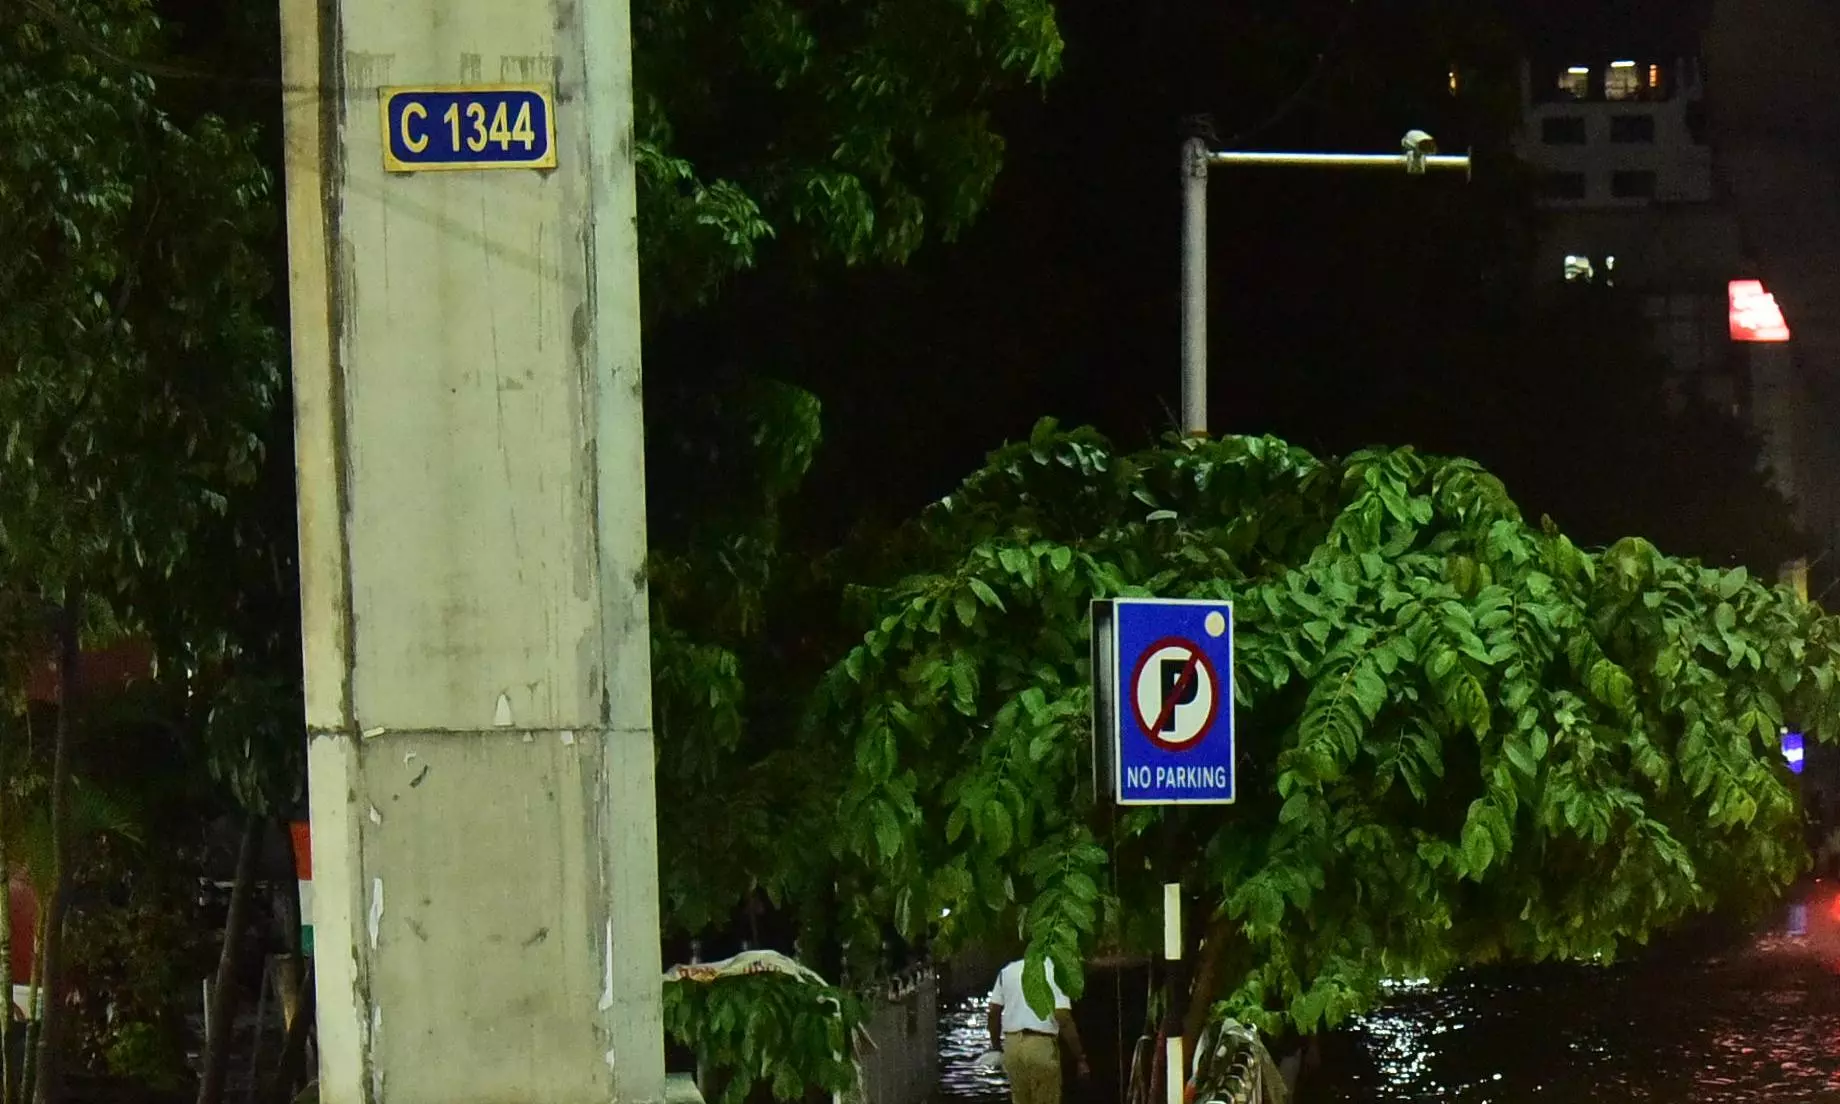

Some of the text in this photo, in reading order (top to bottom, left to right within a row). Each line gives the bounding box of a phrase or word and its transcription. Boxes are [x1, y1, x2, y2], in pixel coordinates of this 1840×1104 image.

[400, 100, 536, 153] C 1344
[1127, 765, 1227, 789] NO PARKING
